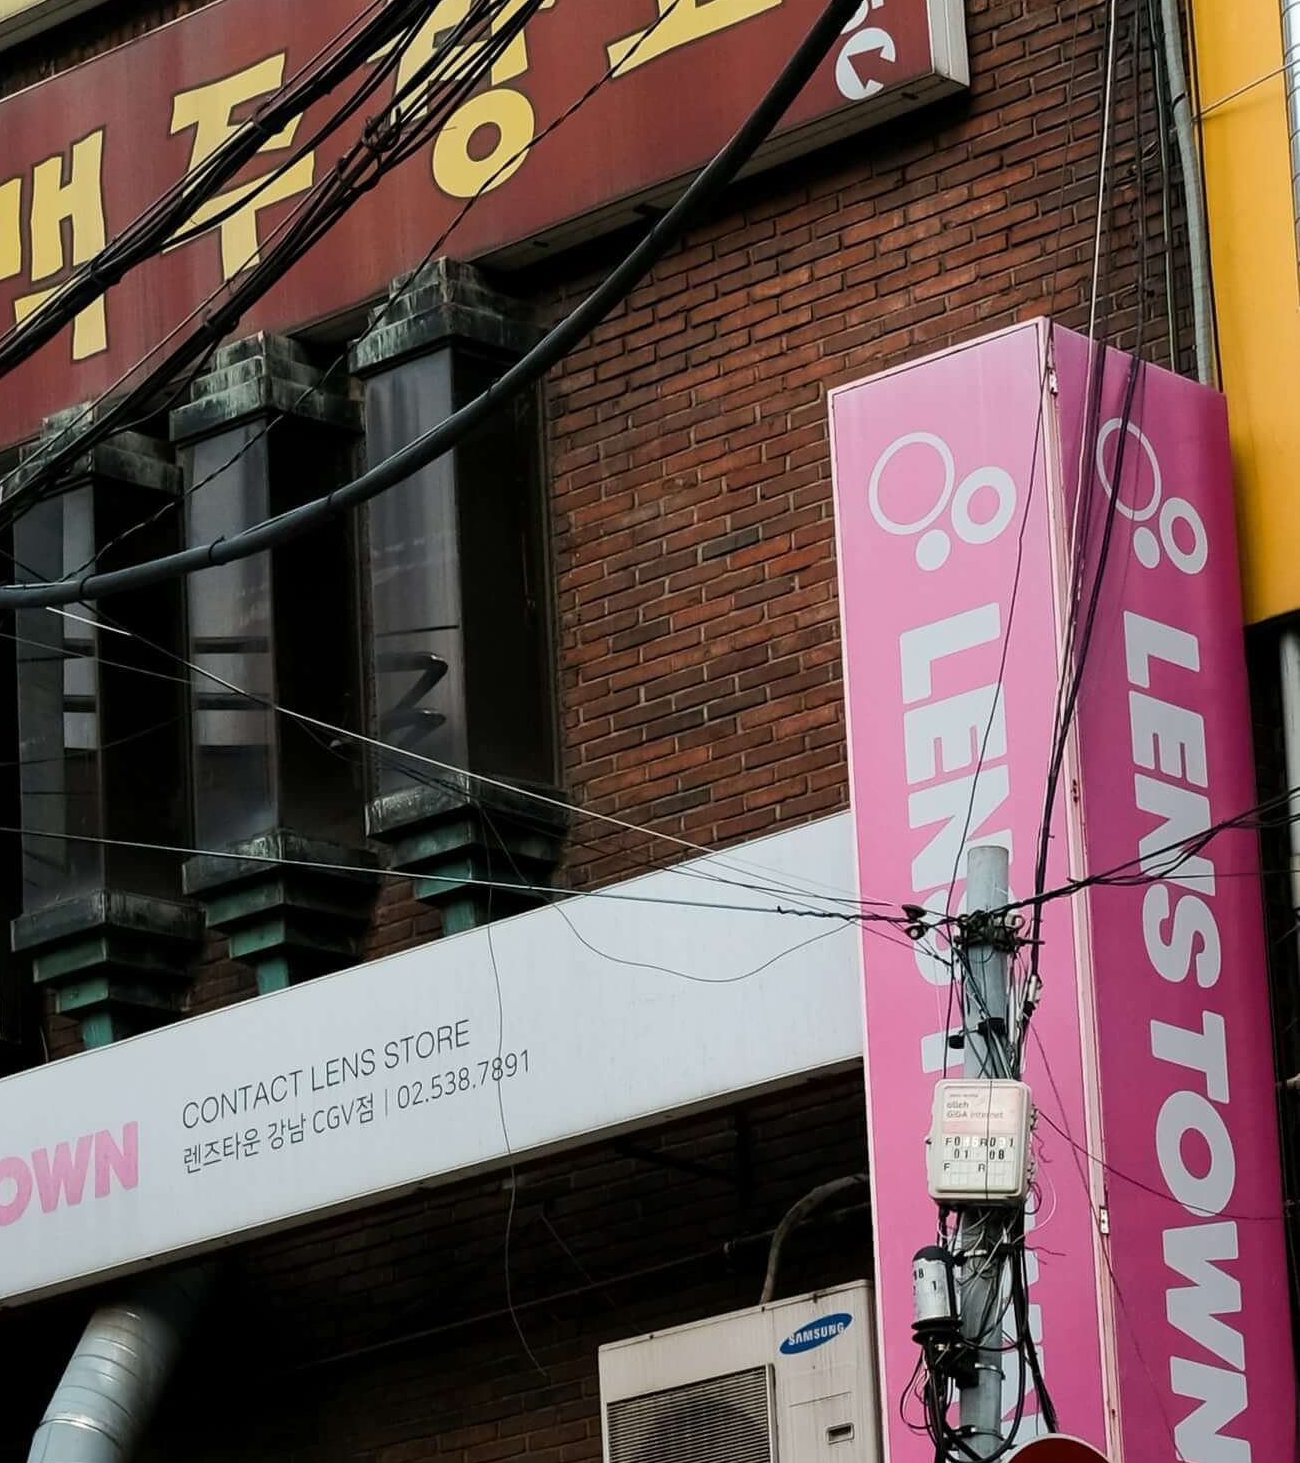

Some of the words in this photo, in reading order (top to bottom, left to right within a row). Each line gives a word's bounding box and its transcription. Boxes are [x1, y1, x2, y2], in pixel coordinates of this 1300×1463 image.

[180, 1069, 303, 1130] CONTACT
[309, 1045, 376, 1098] LENS
[381, 1017, 472, 1074] STORE
[181, 1122, 261, 1175] 렌즈타운
[267, 1112, 308, 1154] 강남
[310, 1088, 376, 1146] CGV점
[394, 1048, 532, 1114] 02.538.7891
[787, 1321, 846, 1347] SAMSUNG
